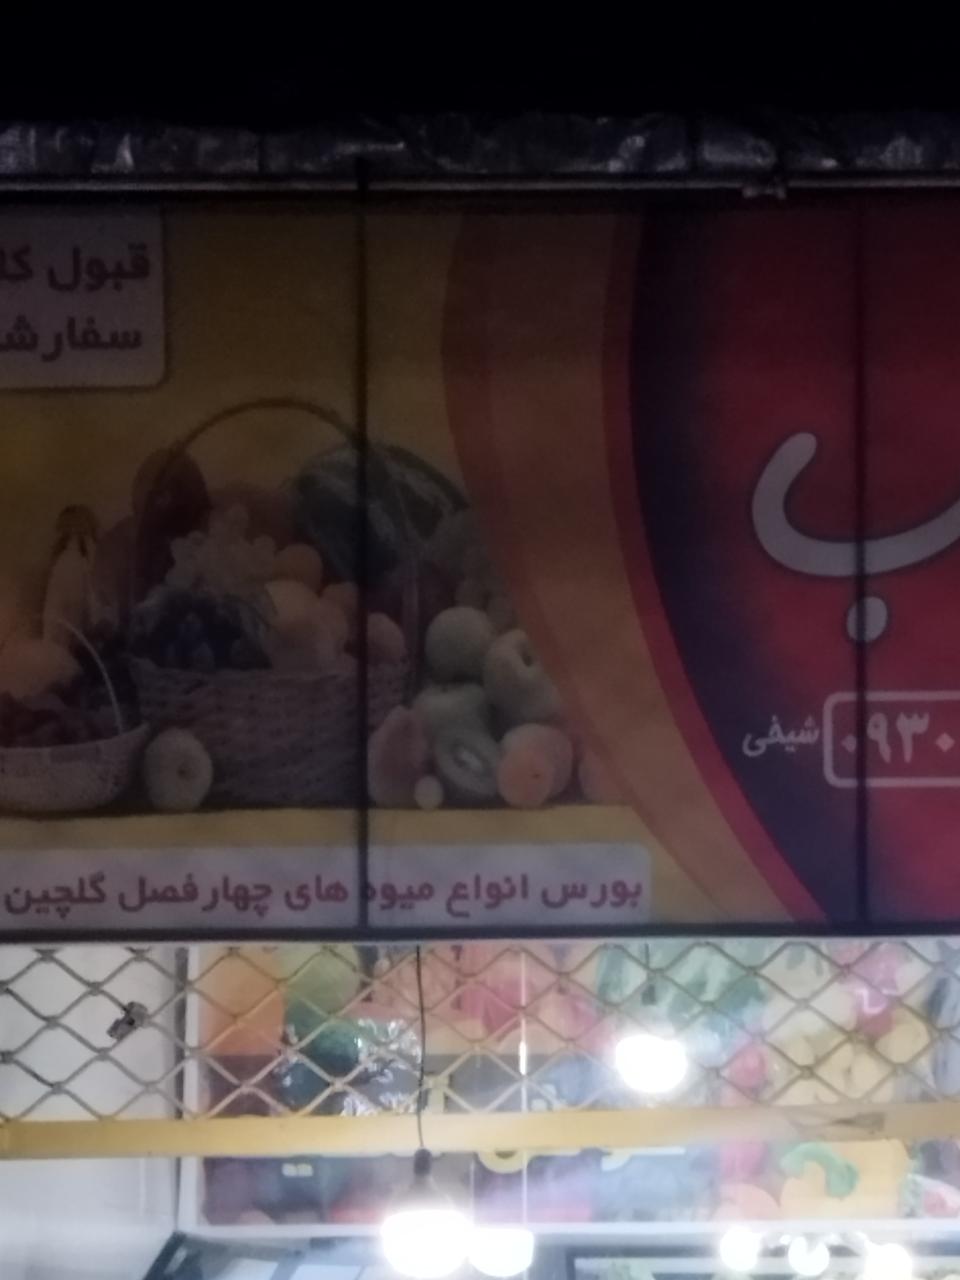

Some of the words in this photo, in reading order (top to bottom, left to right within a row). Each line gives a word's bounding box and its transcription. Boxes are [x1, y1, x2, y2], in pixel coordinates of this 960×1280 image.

[48, 243, 150, 291] قبول
[841, 711, 956, 765] ۰۹۳۰
[3, 871, 106, 919] گلچین
[285, 875, 348, 911] های
[446, 873, 529, 918] انواع
[542, 879, 643, 909] بورس
